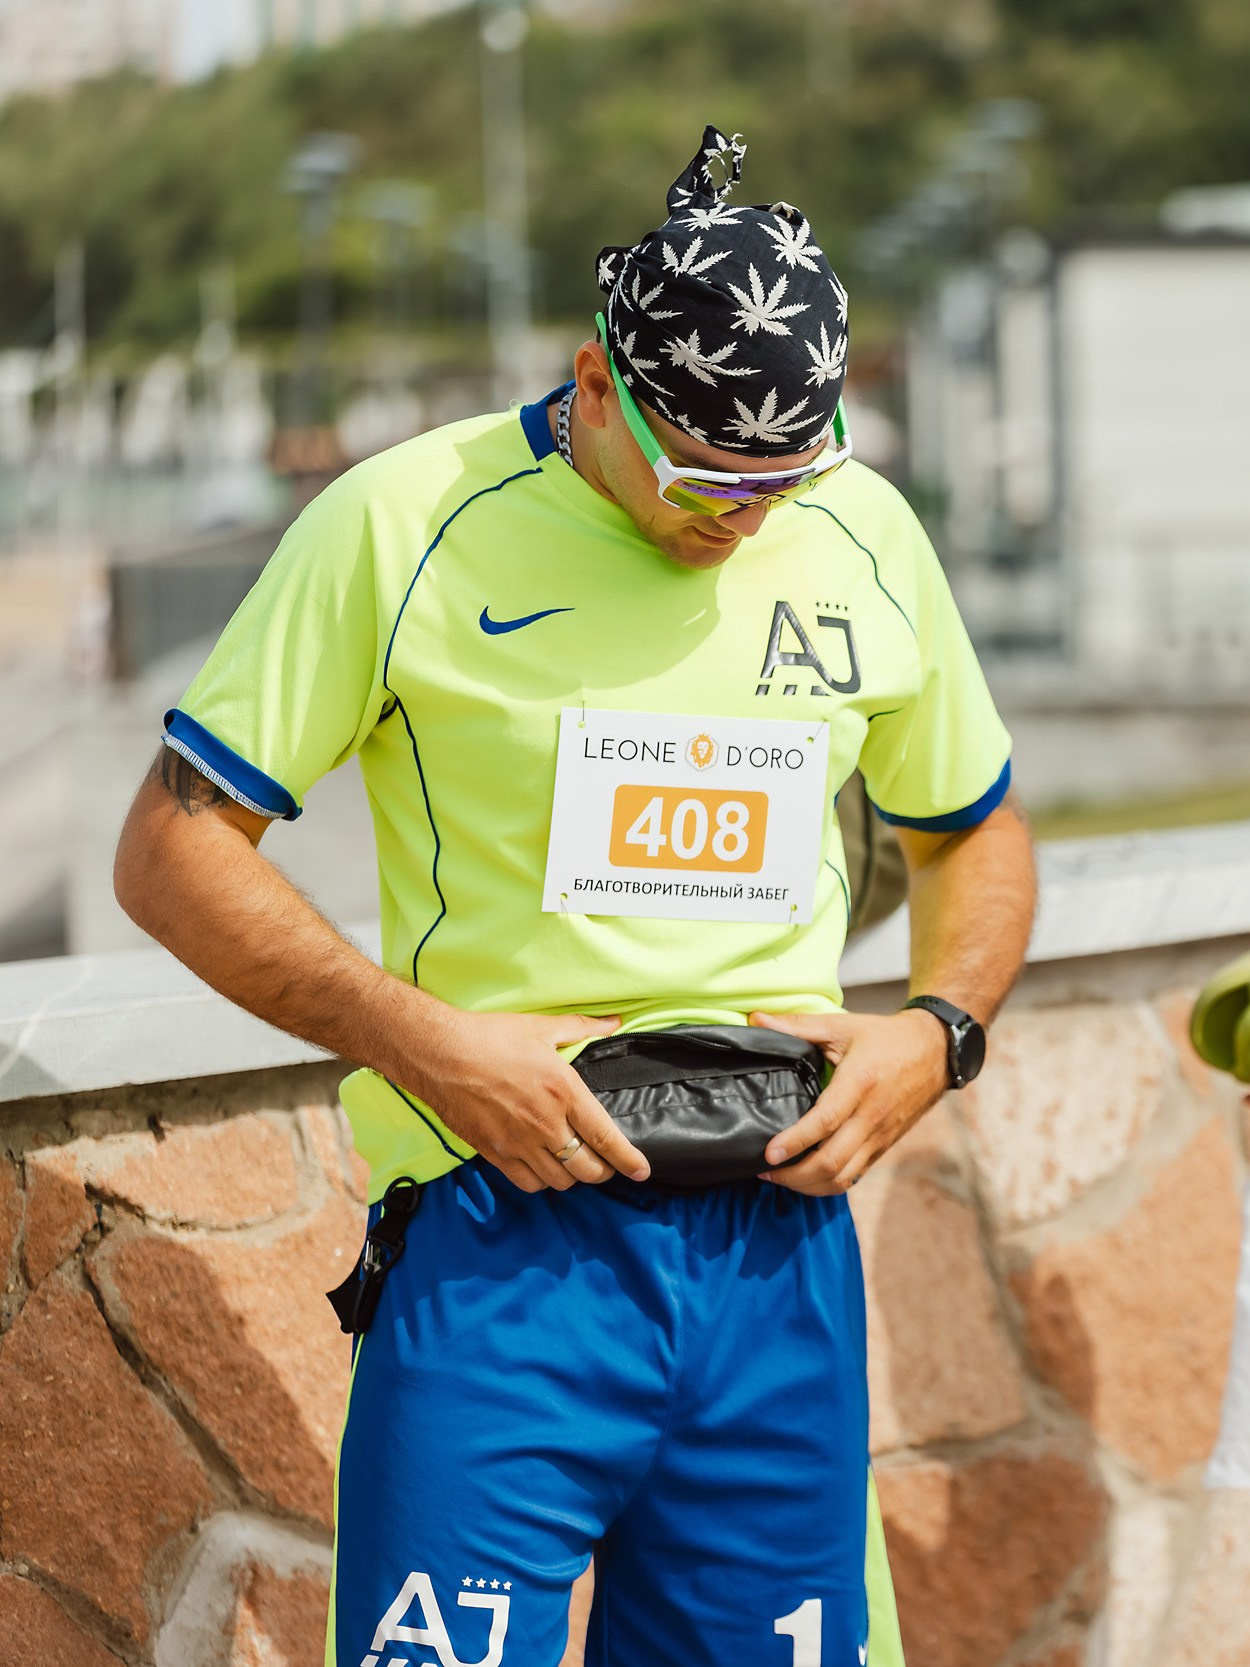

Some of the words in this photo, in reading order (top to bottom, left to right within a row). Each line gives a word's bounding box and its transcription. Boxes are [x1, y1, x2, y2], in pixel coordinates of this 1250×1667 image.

[584, 737, 676, 763] LEONE
[625, 796, 751, 862] 408
[573, 878, 744, 899] БЛАГОТВОРИТЕЛЬНЫЙ
[747, 887, 790, 901] ЗАБЕГ
